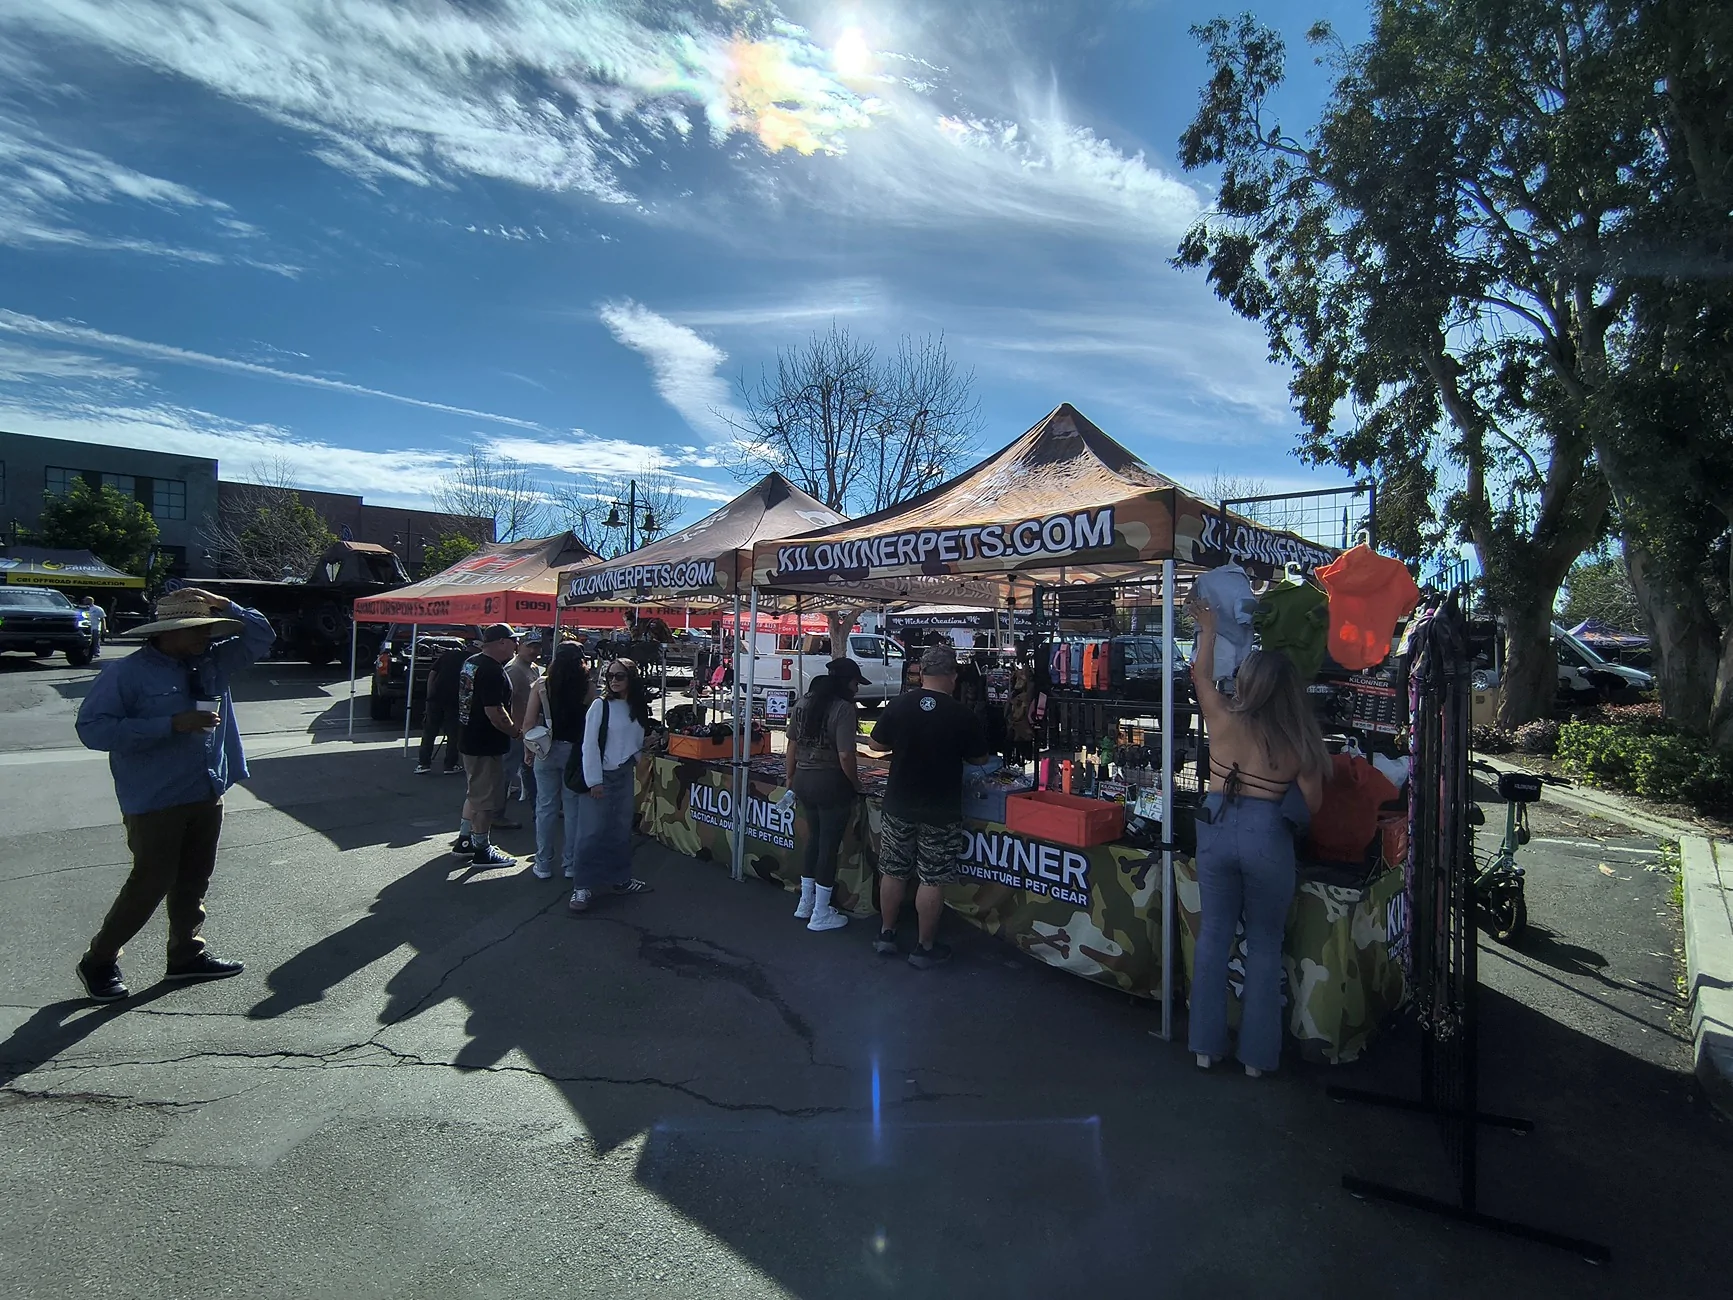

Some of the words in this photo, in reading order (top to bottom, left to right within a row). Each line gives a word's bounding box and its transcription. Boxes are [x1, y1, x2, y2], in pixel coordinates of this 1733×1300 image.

[777, 509, 1113, 573] KILONINERPETS.COM
[73, 579, 126, 587] FABRICATION
[569, 561, 715, 597] KILONINERPETS.COM
[515, 600, 551, 612] (909)
[905, 617, 930, 626] Wicked
[931, 616, 967, 624] Creations
[1349, 676, 1389, 688] KILONINER
[690, 809, 719, 826] TACTICAL
[758, 830, 772, 843] PET
[773, 836, 794, 849] GEAR
[955, 864, 1021, 888] ADVENTURE
[1025, 878, 1048, 895] PET
[1051, 886, 1087, 906] GEAR
